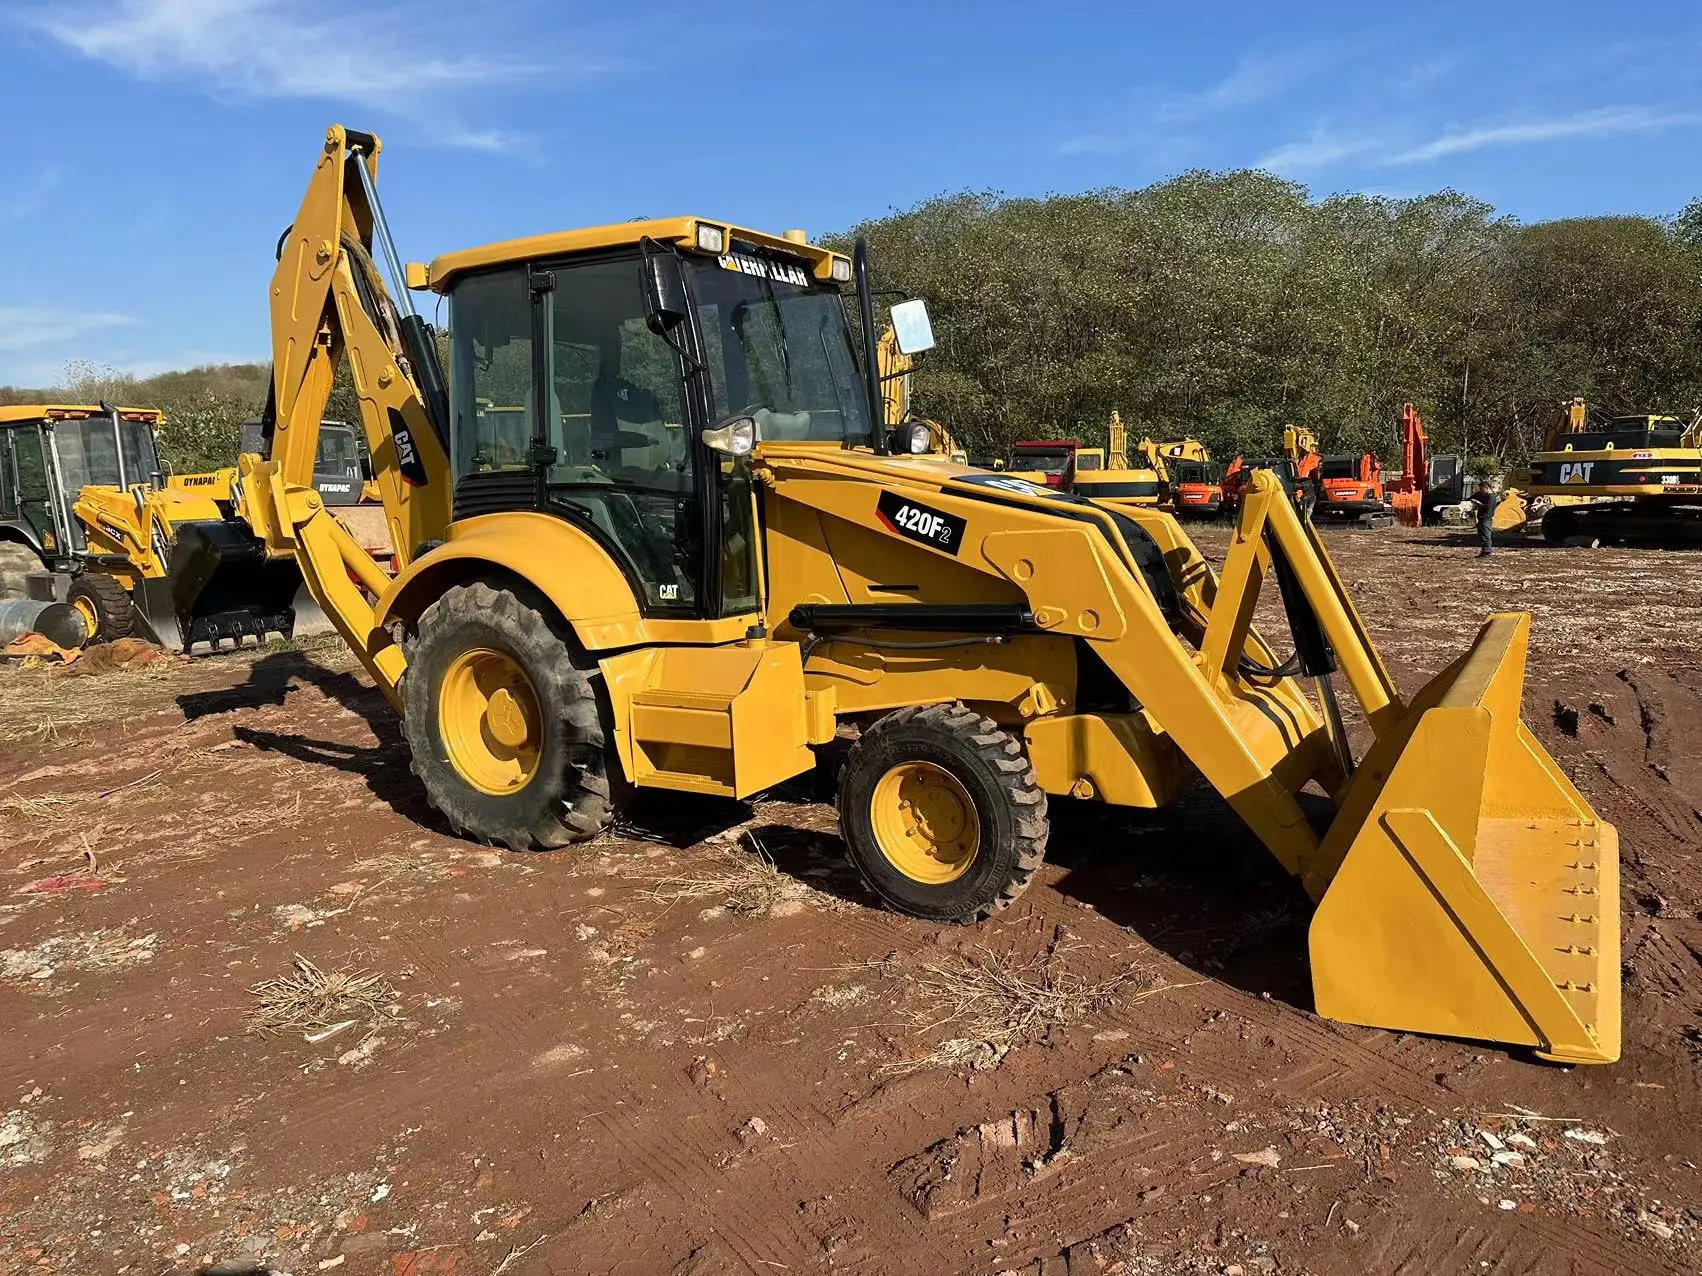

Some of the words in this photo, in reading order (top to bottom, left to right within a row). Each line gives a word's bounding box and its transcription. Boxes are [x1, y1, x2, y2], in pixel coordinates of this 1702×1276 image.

[718, 251, 809, 287] CATERPILLAR
[394, 430, 416, 466] CAT
[1559, 462, 1595, 485] CAT
[319, 483, 351, 493] DYNAPAC
[659, 584, 679, 600] CAT
